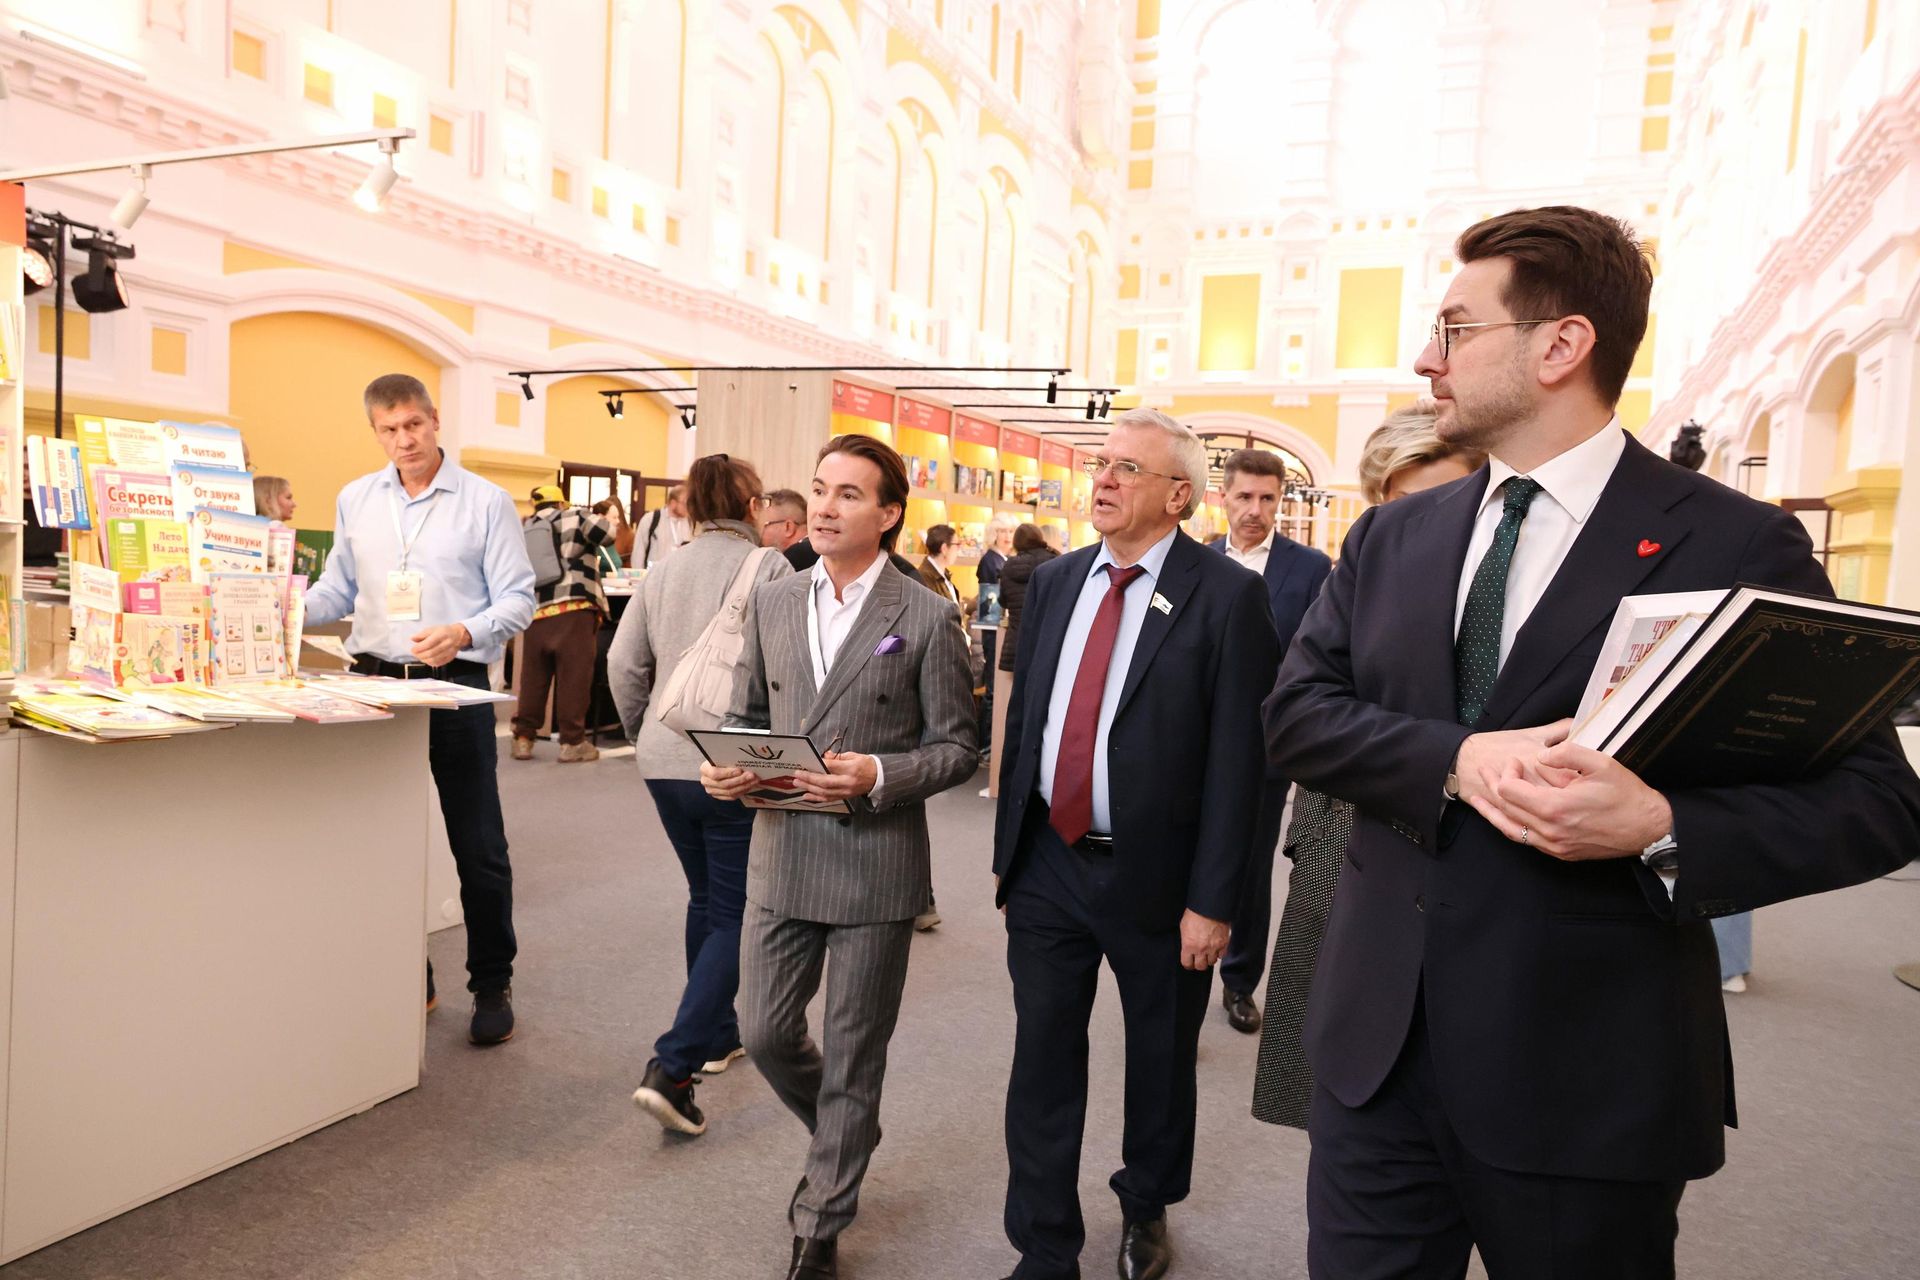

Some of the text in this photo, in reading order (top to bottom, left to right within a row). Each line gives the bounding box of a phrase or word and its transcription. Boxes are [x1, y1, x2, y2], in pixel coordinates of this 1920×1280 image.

[191, 446, 226, 459] читаю
[194, 486, 240, 502] От звука
[159, 531, 182, 541] Лето
[204, 528, 262, 548] Учим звуки
[153, 543, 166, 552] На
